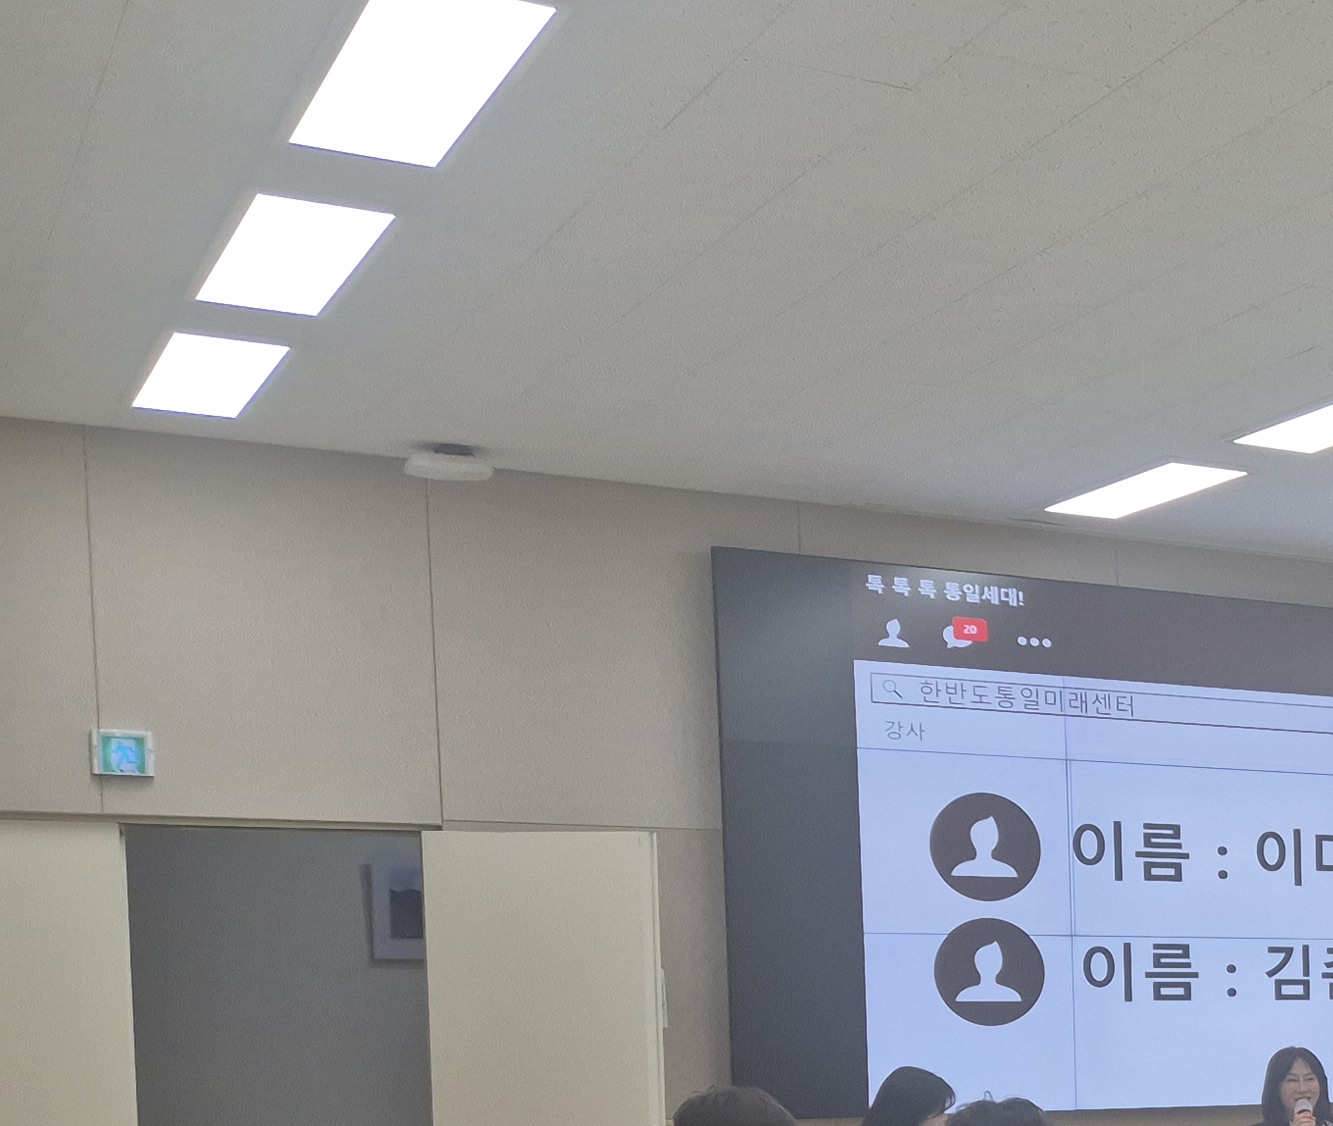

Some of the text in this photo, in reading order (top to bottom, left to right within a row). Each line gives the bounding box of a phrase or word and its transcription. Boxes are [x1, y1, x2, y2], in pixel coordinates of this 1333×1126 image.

[865, 574, 1025, 607] 톡 톡 톡 통일세대!
[963, 624, 977, 635] 20
[919, 679, 1135, 718] 한반도통일미래센터
[884, 720, 926, 742] 강사
[1072, 820, 1190, 883] 이름
[1082, 942, 1199, 1002] 이름
